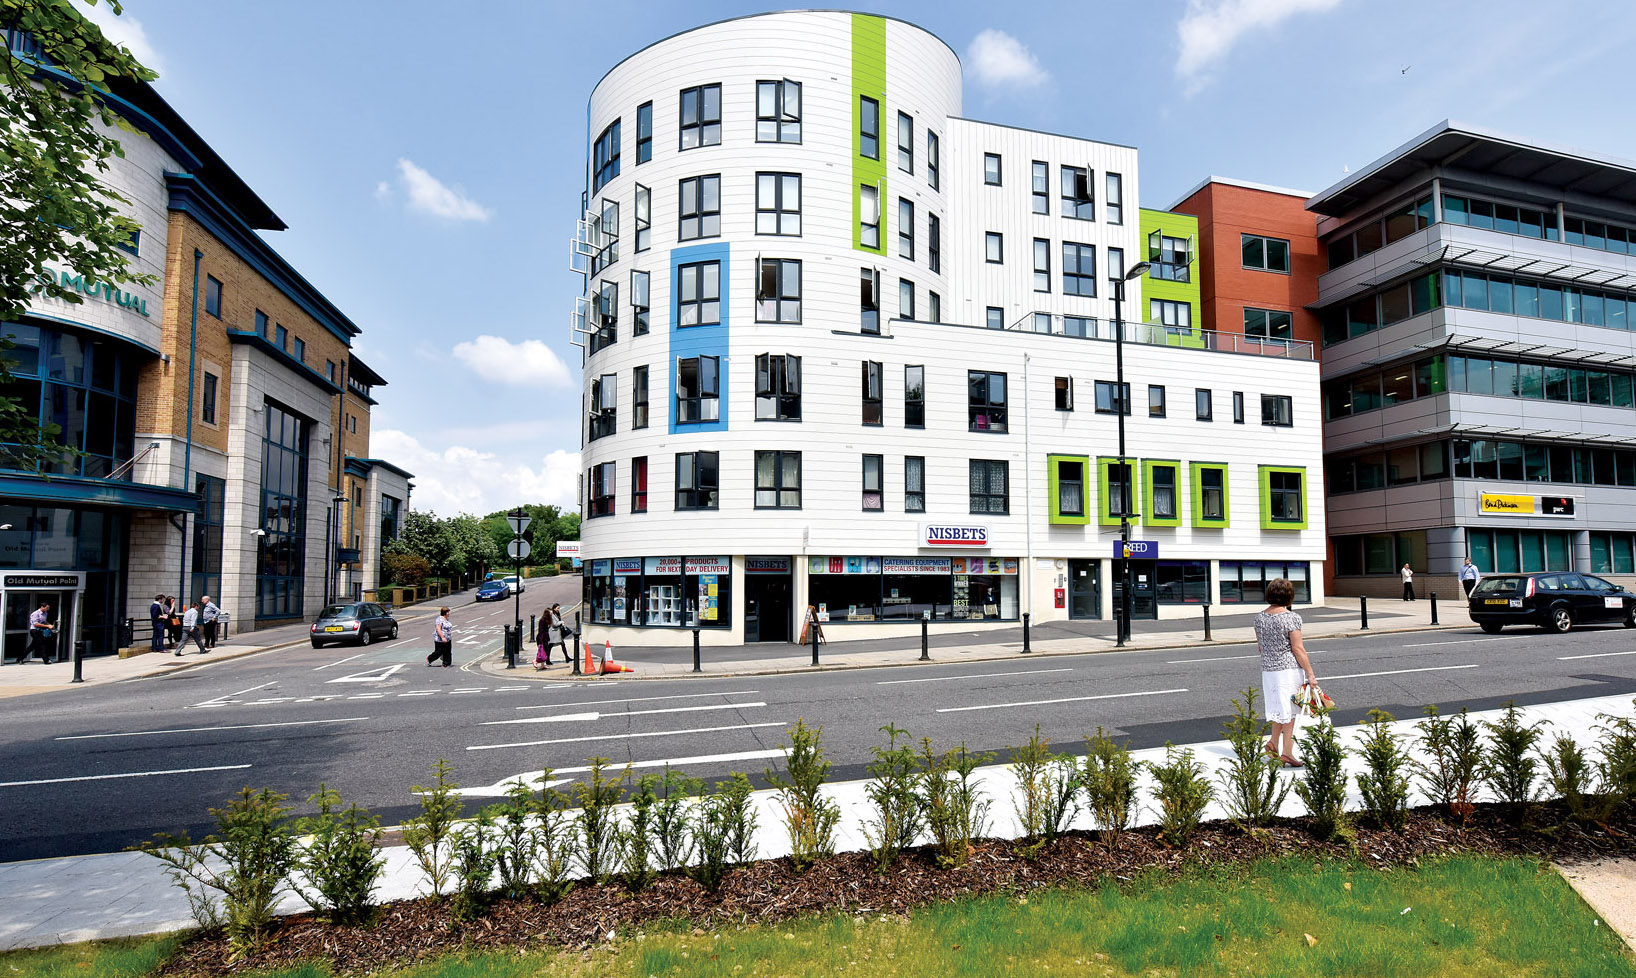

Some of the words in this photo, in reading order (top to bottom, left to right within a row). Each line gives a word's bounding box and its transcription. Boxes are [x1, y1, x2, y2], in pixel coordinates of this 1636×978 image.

[61, 271, 150, 317] MUTUAL
[928, 527, 986, 540] NISBETS
[1127, 542, 1147, 552] REED
[615, 561, 641, 569] NISBETS
[747, 560, 787, 568] NISBETS
[699, 565, 729, 573] DELIVERY
